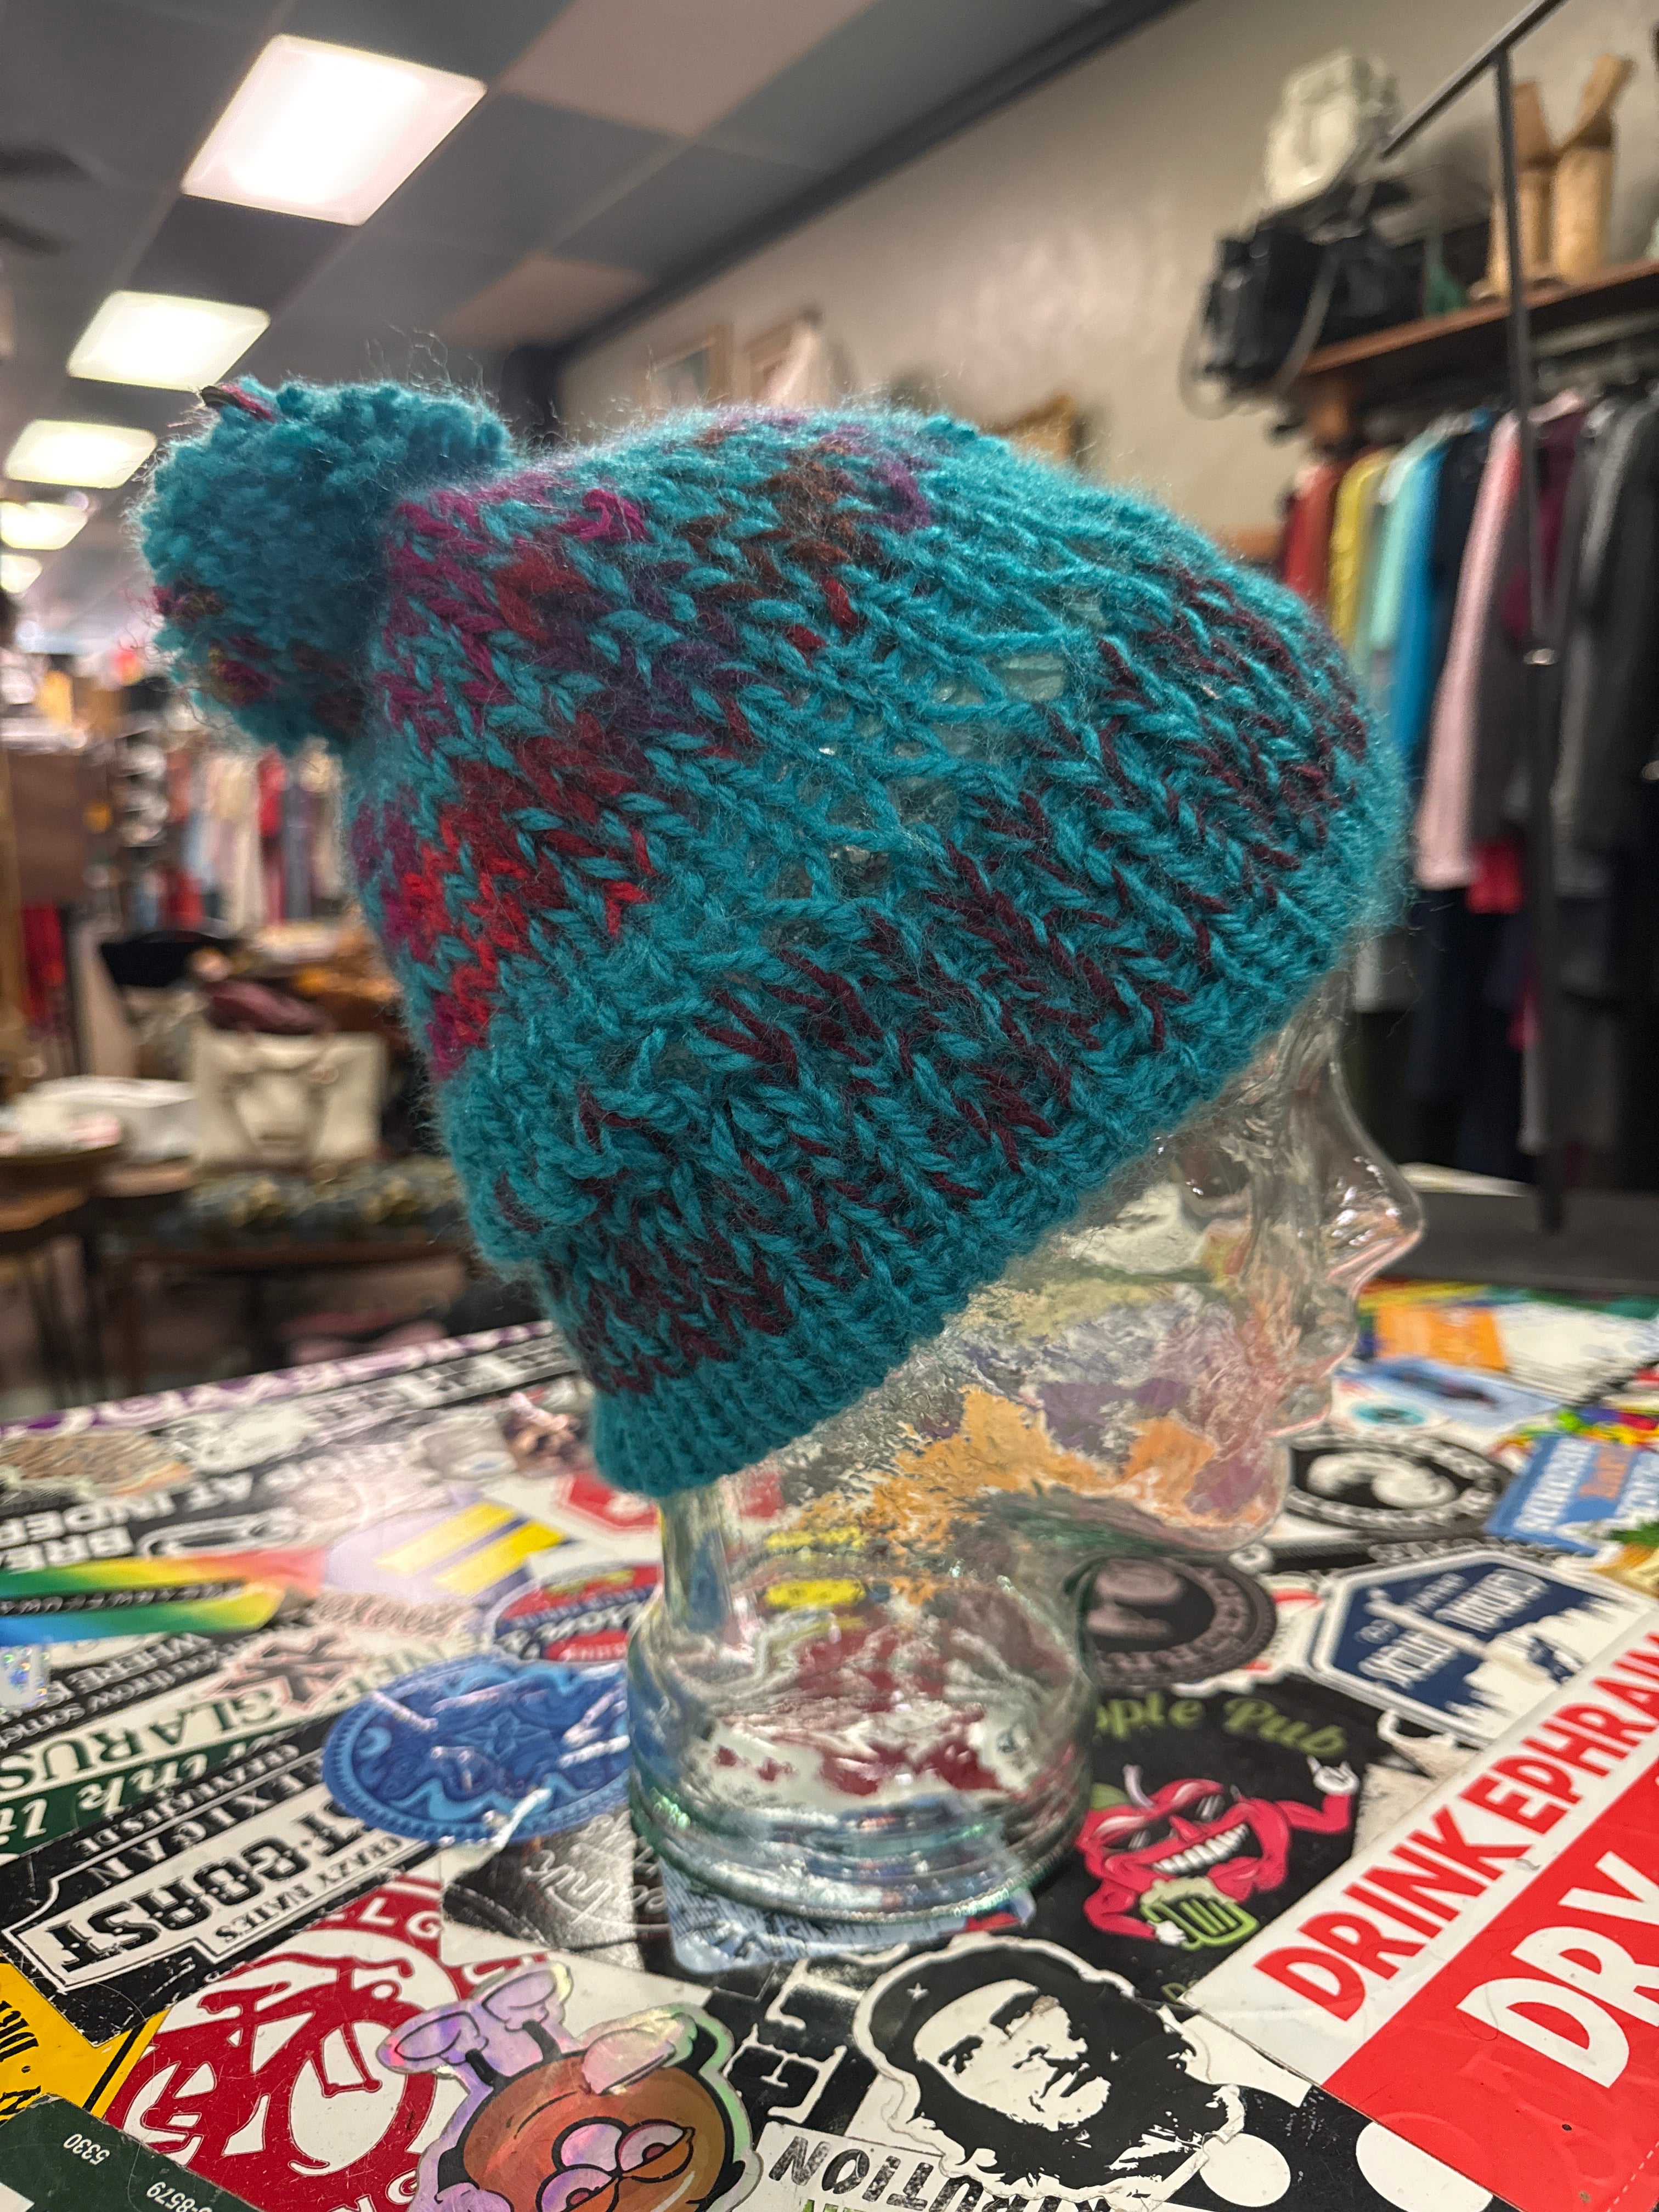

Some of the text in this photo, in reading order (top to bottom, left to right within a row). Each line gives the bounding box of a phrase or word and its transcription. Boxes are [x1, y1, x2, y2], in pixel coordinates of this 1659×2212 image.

[0, 1526, 133, 1571] BRE
[0, 1688, 279, 1794] GLARUS
[1223, 1697, 1348, 1758] Pub
[85, 1763, 322, 1887] EXICAN
[1254, 1804, 1534, 2022] DRINK
[1458, 1630, 1659, 1835] EPHRAI
[314, 1837, 403, 1891] CRAZY
[63, 2132, 111, 2166] 5330
